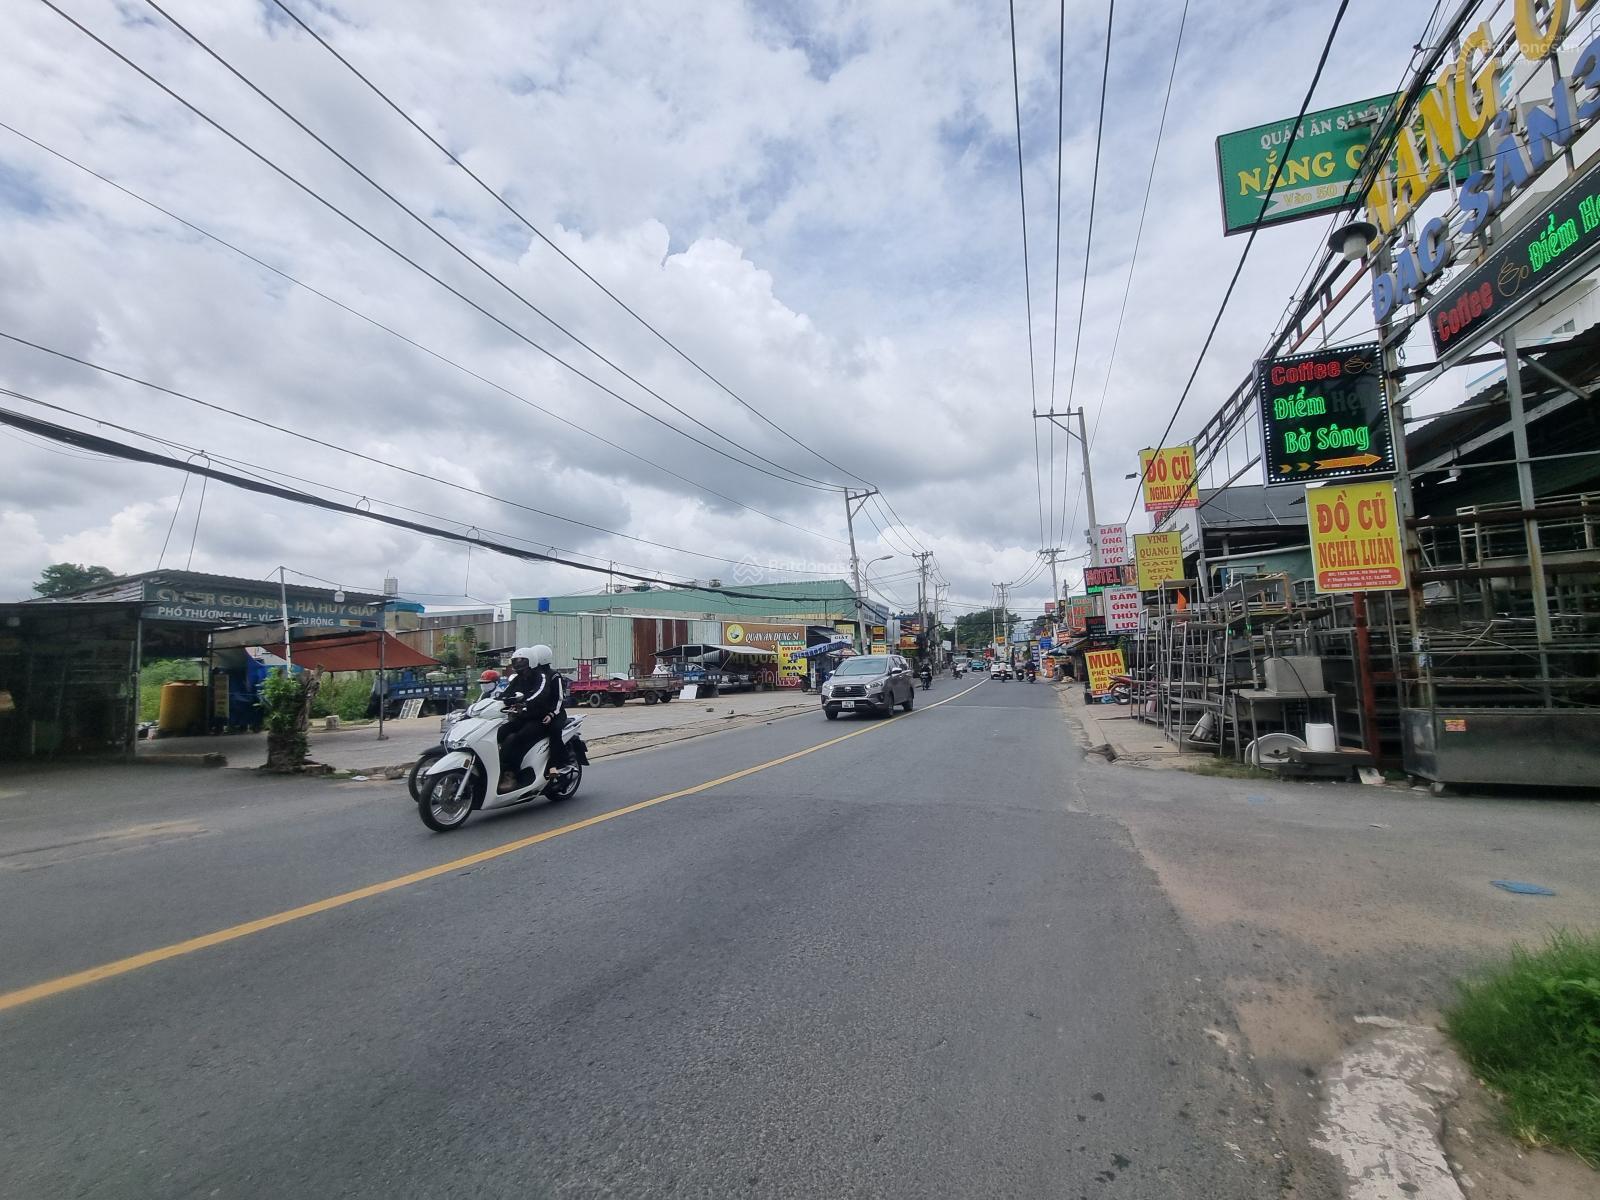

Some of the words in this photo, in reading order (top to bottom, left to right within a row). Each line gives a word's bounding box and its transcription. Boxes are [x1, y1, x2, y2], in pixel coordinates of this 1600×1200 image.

[1310, 120, 1333, 138] ĂN
[1459, 79, 1565, 234] SẢN
[1238, 150, 1336, 196] NẮNG
[1437, 281, 1494, 342] Coffee
[1528, 213, 1579, 273] Điểm
[1271, 361, 1341, 385] Coffee
[1274, 386, 1327, 420] Điểm
[1284, 428, 1311, 453] Bờ
[1317, 424, 1369, 451] Sông
[1316, 490, 1351, 534] ĐỒ
[1358, 490, 1388, 531] CŨ
[1087, 567, 1120, 586] HOTEL
[1088, 653, 1122, 669] MUA
